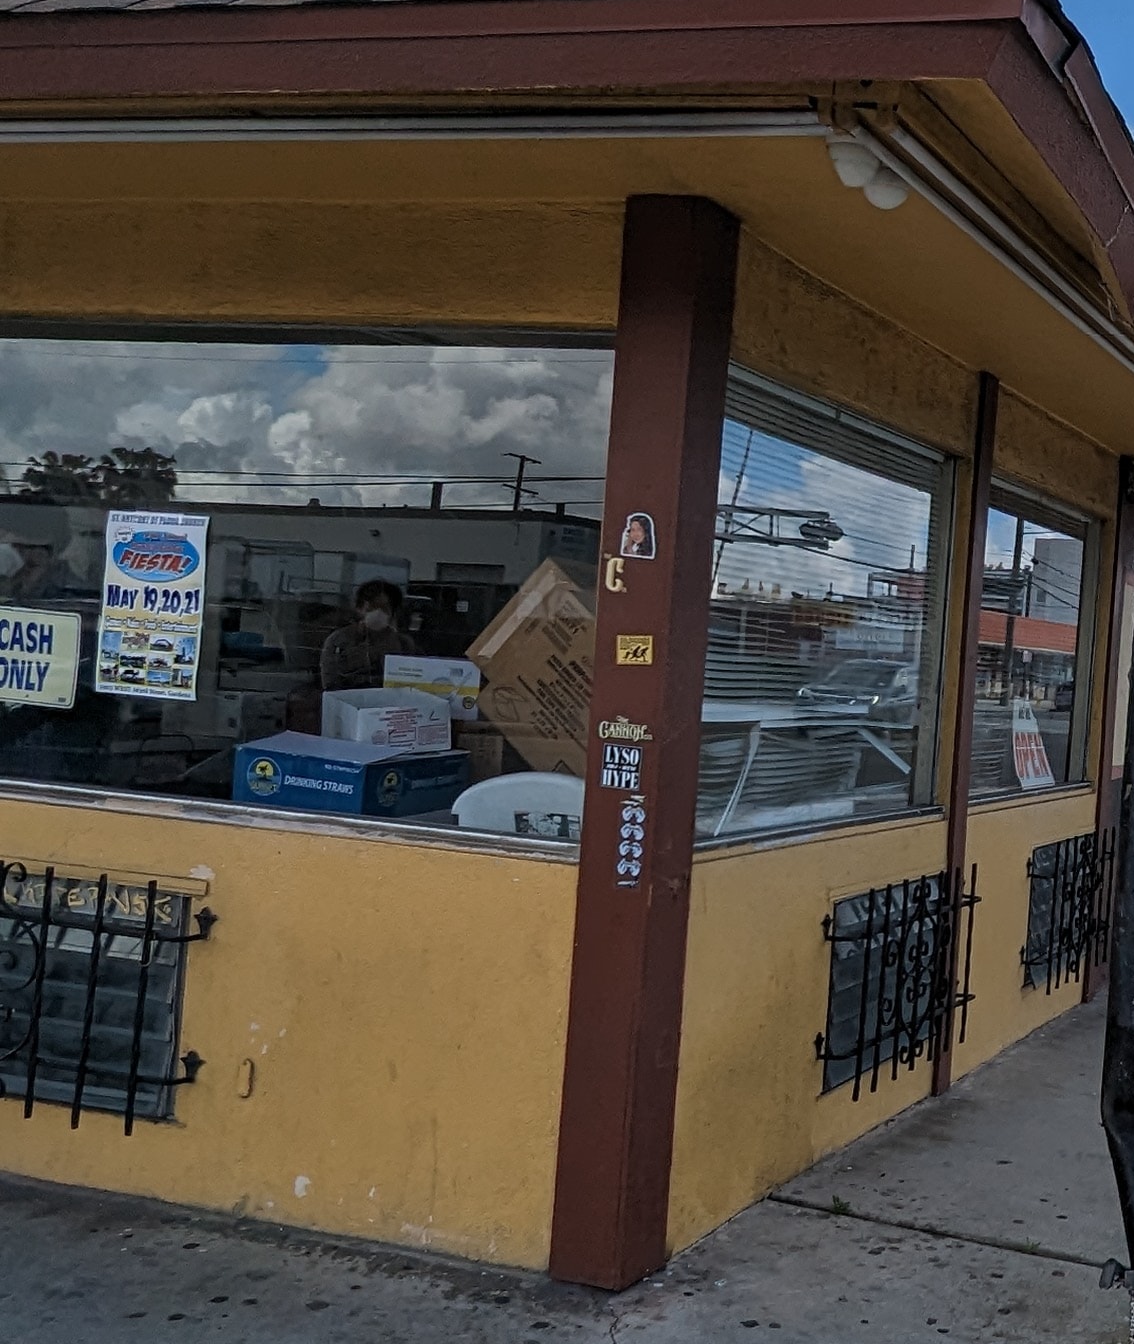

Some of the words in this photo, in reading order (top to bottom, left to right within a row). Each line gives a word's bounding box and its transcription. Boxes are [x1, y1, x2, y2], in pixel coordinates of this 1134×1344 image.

[119, 549, 193, 574] FIESTA!
[0, 618, 53, 655] CASH
[0, 656, 51, 692] ONLY
[605, 745, 640, 766] LYSO
[1014, 732, 1051, 779] OPEN
[283, 775, 322, 791] DRINKING
[322, 780, 354, 796] STRAWS
[602, 769, 639, 789] HYPE
